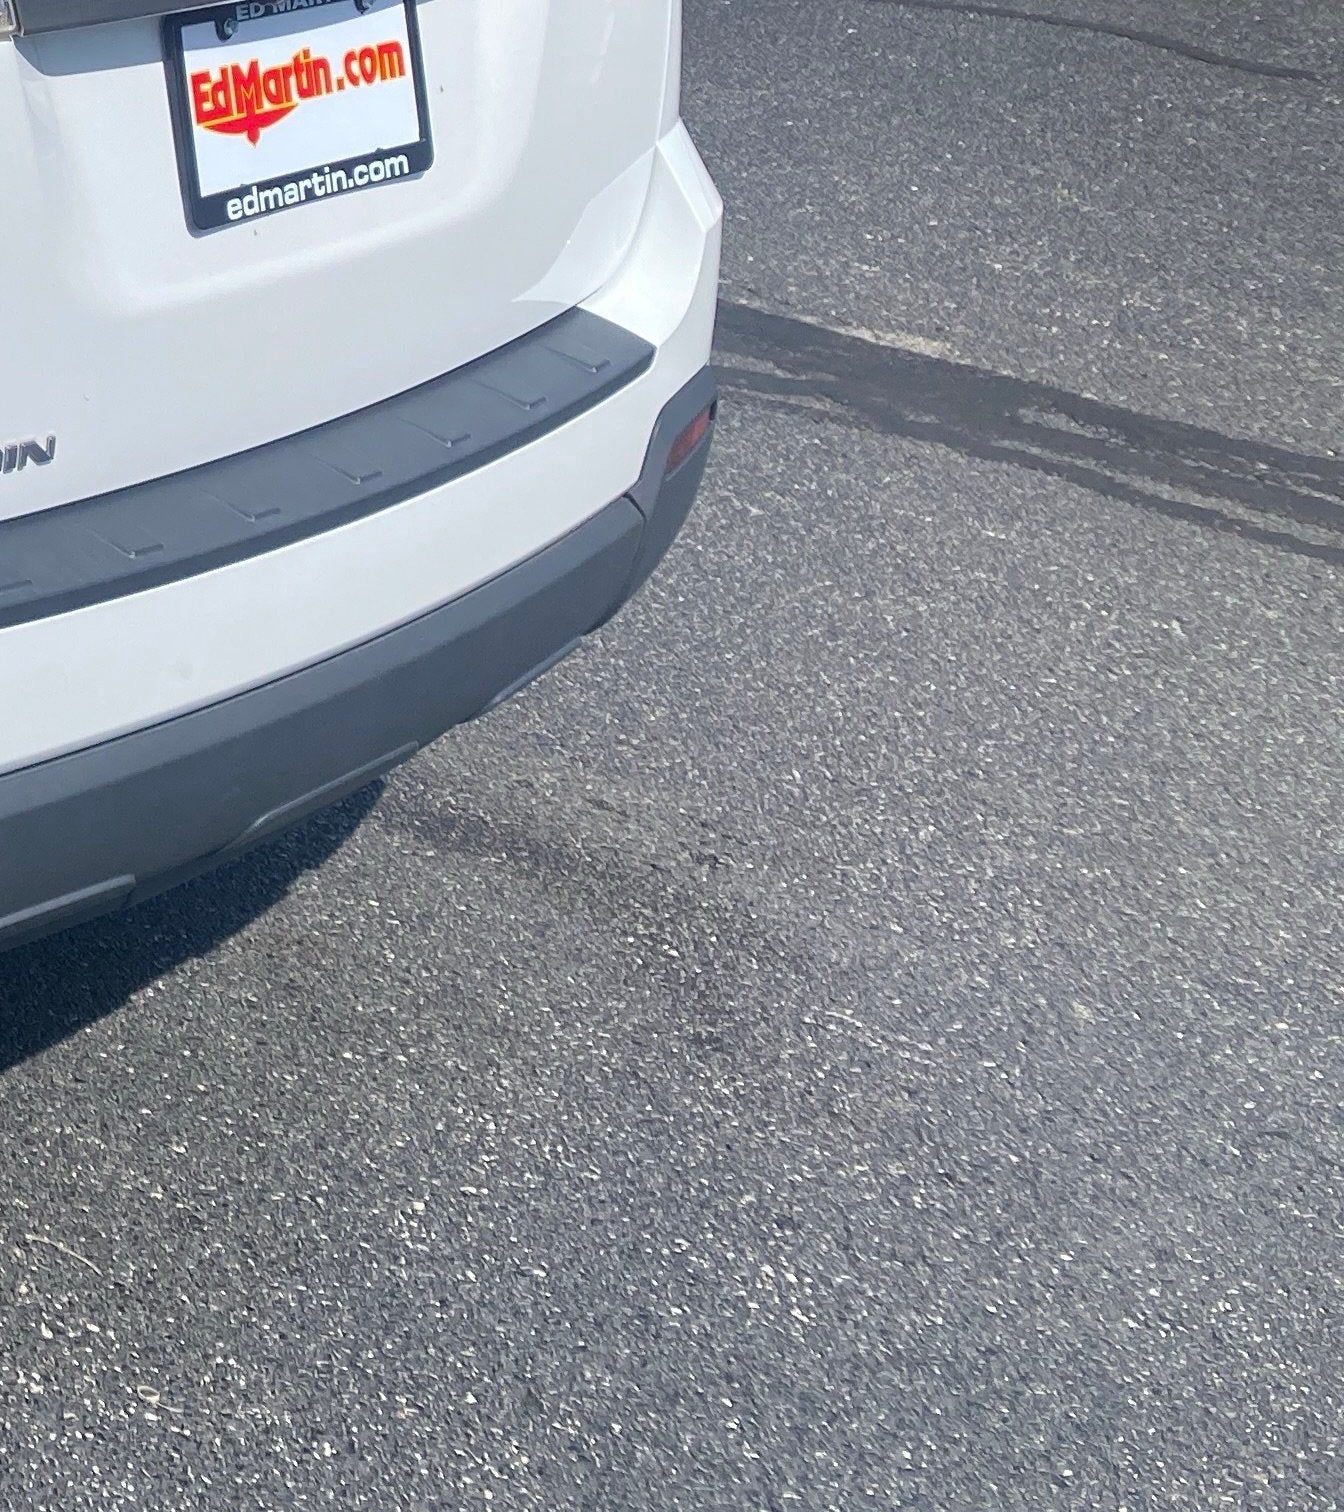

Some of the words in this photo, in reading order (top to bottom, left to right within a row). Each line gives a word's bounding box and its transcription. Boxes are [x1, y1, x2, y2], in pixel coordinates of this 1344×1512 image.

[235, 0, 265, 22] ED
[190, 39, 407, 125] EdMartin.com
[226, 153, 410, 221] edmartin.com
